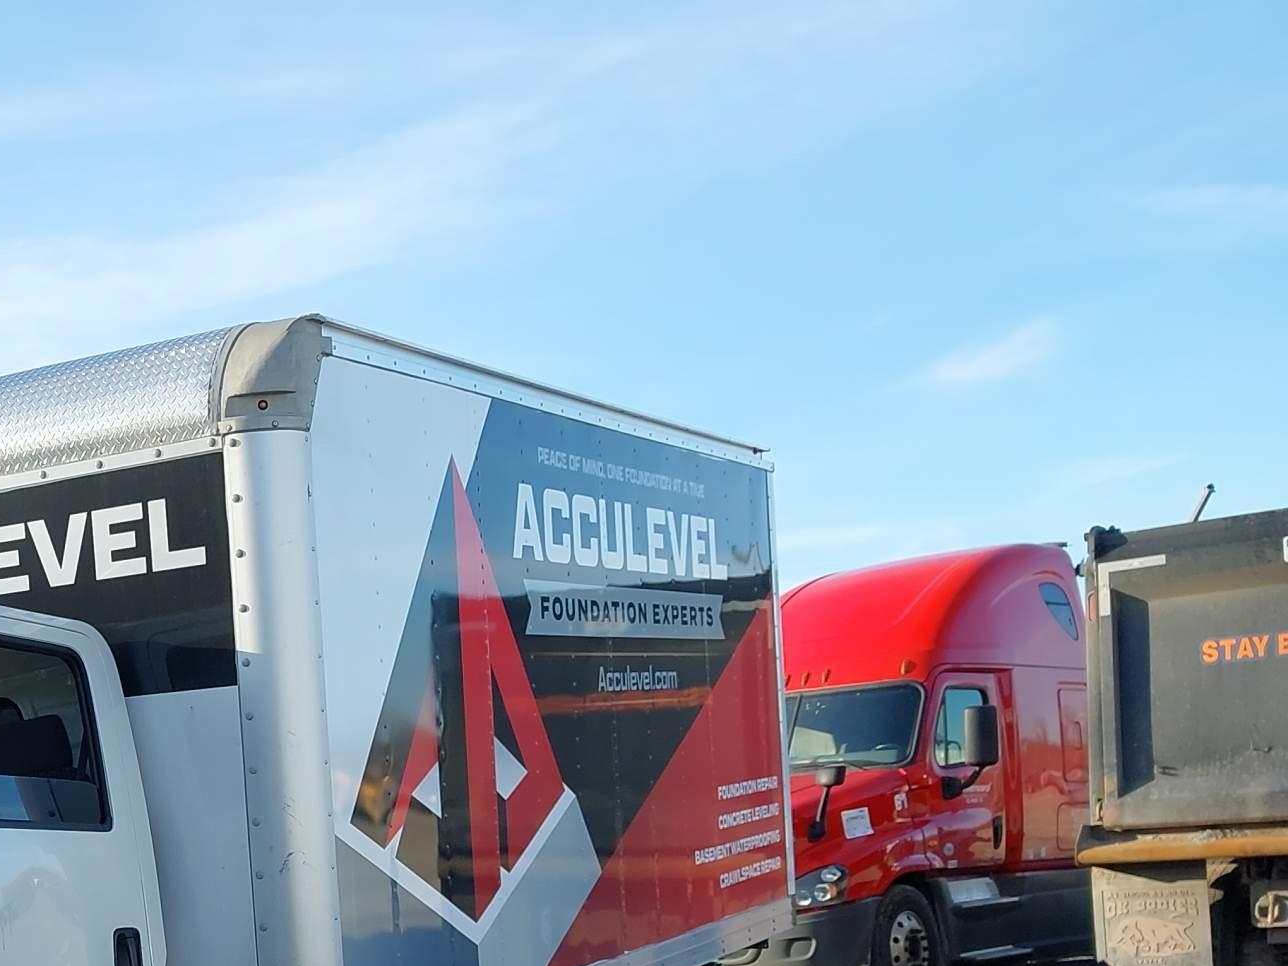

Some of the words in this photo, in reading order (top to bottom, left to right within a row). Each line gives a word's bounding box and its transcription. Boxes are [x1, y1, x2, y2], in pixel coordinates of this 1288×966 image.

[537, 446, 567, 469] PEACE
[569, 453, 580, 471] OF
[606, 463, 623, 481] ONE
[673, 477, 682, 493] AT
[683, 480, 689, 493] A
[512, 482, 728, 580] ACCULEVEL
[540, 596, 647, 624] FOUNDATION
[652, 603, 714, 627] EXPERTS
[1201, 634, 1269, 663] STAY
[598, 665, 678, 692] Acculevel.com
